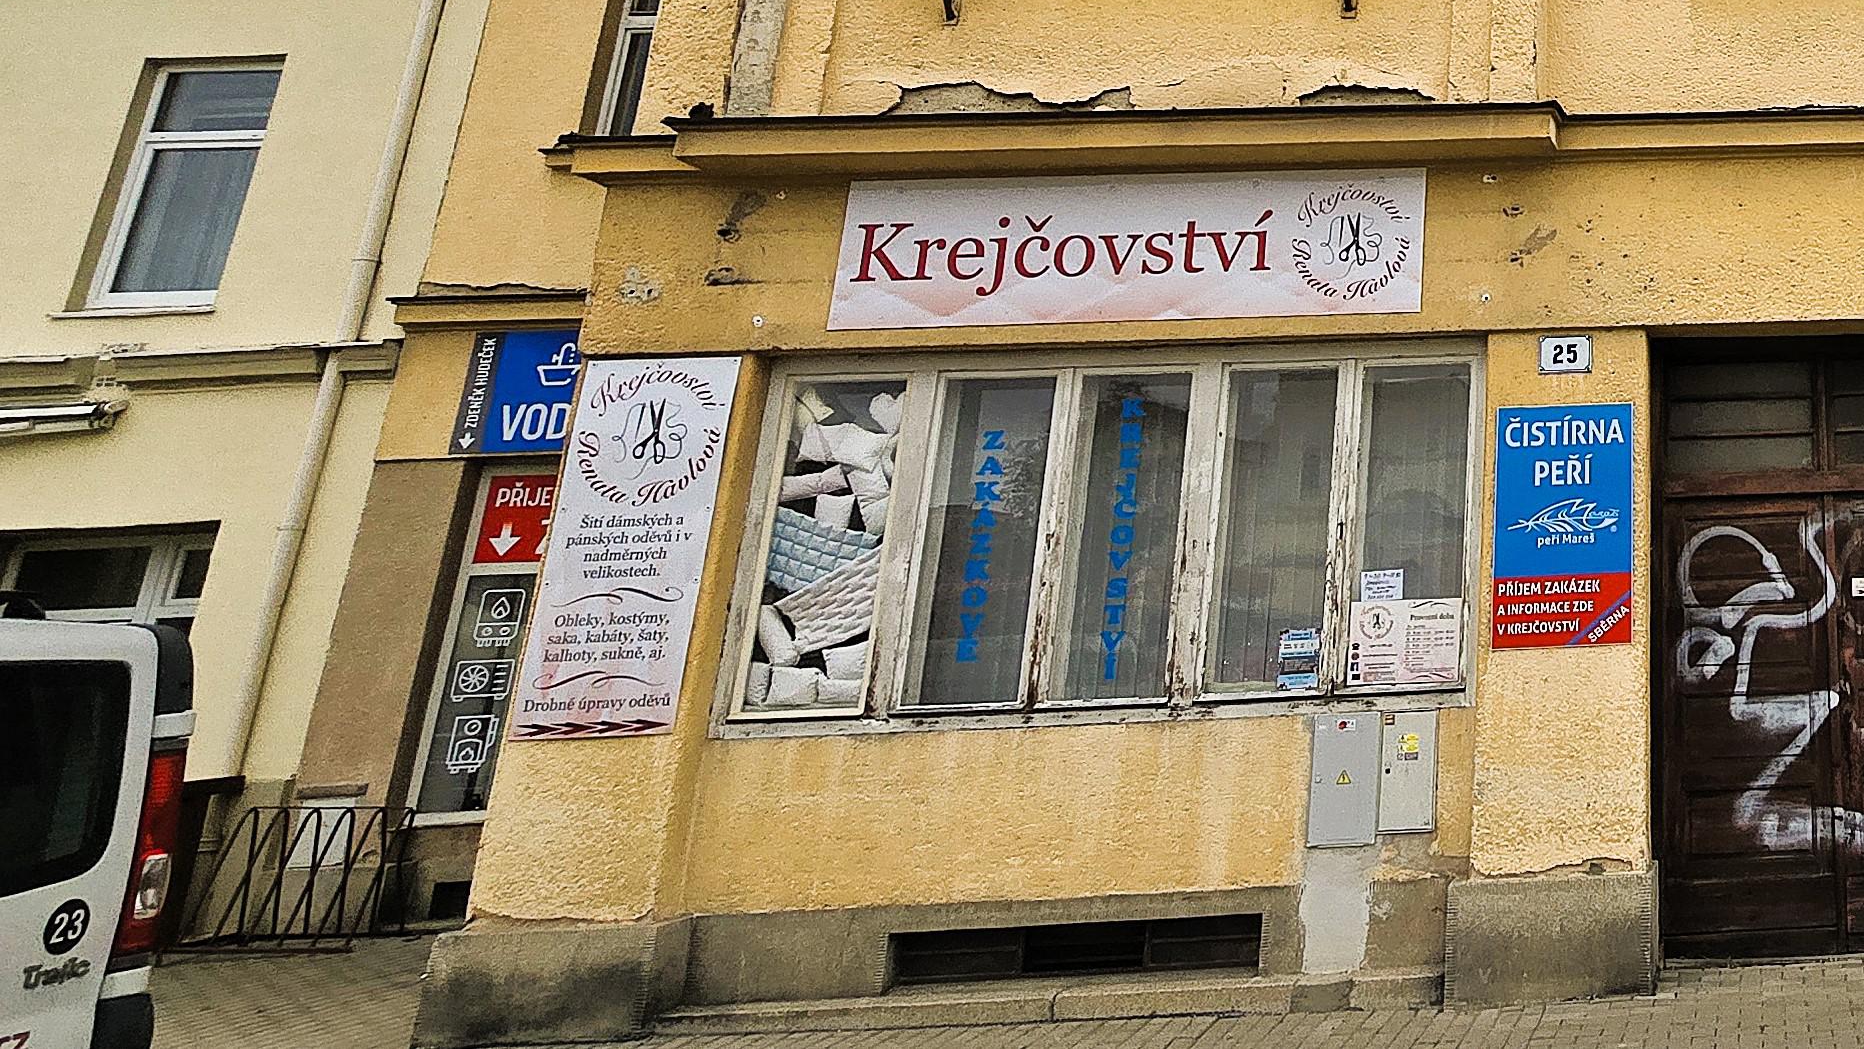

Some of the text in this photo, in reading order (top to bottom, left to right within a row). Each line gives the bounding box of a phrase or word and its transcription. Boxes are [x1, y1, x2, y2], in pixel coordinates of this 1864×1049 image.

[1297, 183, 1411, 228] Krejčovství
[849, 208, 1274, 297] Krejčovství
[1291, 235, 1411, 301] Renata Havlová
[1552, 343, 1578, 365] 25
[463, 337, 497, 429] ZDENĚK HUDEČEK
[590, 361, 726, 418] Krejčovství
[1504, 415, 1625, 448] ČISTÍRNA
[576, 425, 722, 507] Renata Havlová
[1534, 454, 1594, 487] PEŘÍ
[580, 514, 685, 530] Šití dámských a
[566, 529, 694, 549] pánských oděvů i v
[1537, 532, 1595, 549] peří Mareš
[583, 549, 667, 564] nadměrných
[582, 565, 661, 579] velikostech.
[1498, 577, 1601, 597] PŘÍJEM ZAKÁZEK
[1496, 600, 1594, 616] A INFORMACE ZDE
[554, 611, 671, 630] Obleky, kostýmy,
[1496, 618, 1580, 635] V KREJČOVSTVÍ
[1587, 604, 1630, 643] SBĚRNA
[547, 627, 670, 646] saka, kabáty, šaty,
[542, 647, 666, 664] kalhoty, sukně, aj.
[522, 693, 671, 714] Drobné úpravy oděvů
[49, 908, 86, 945] 23
